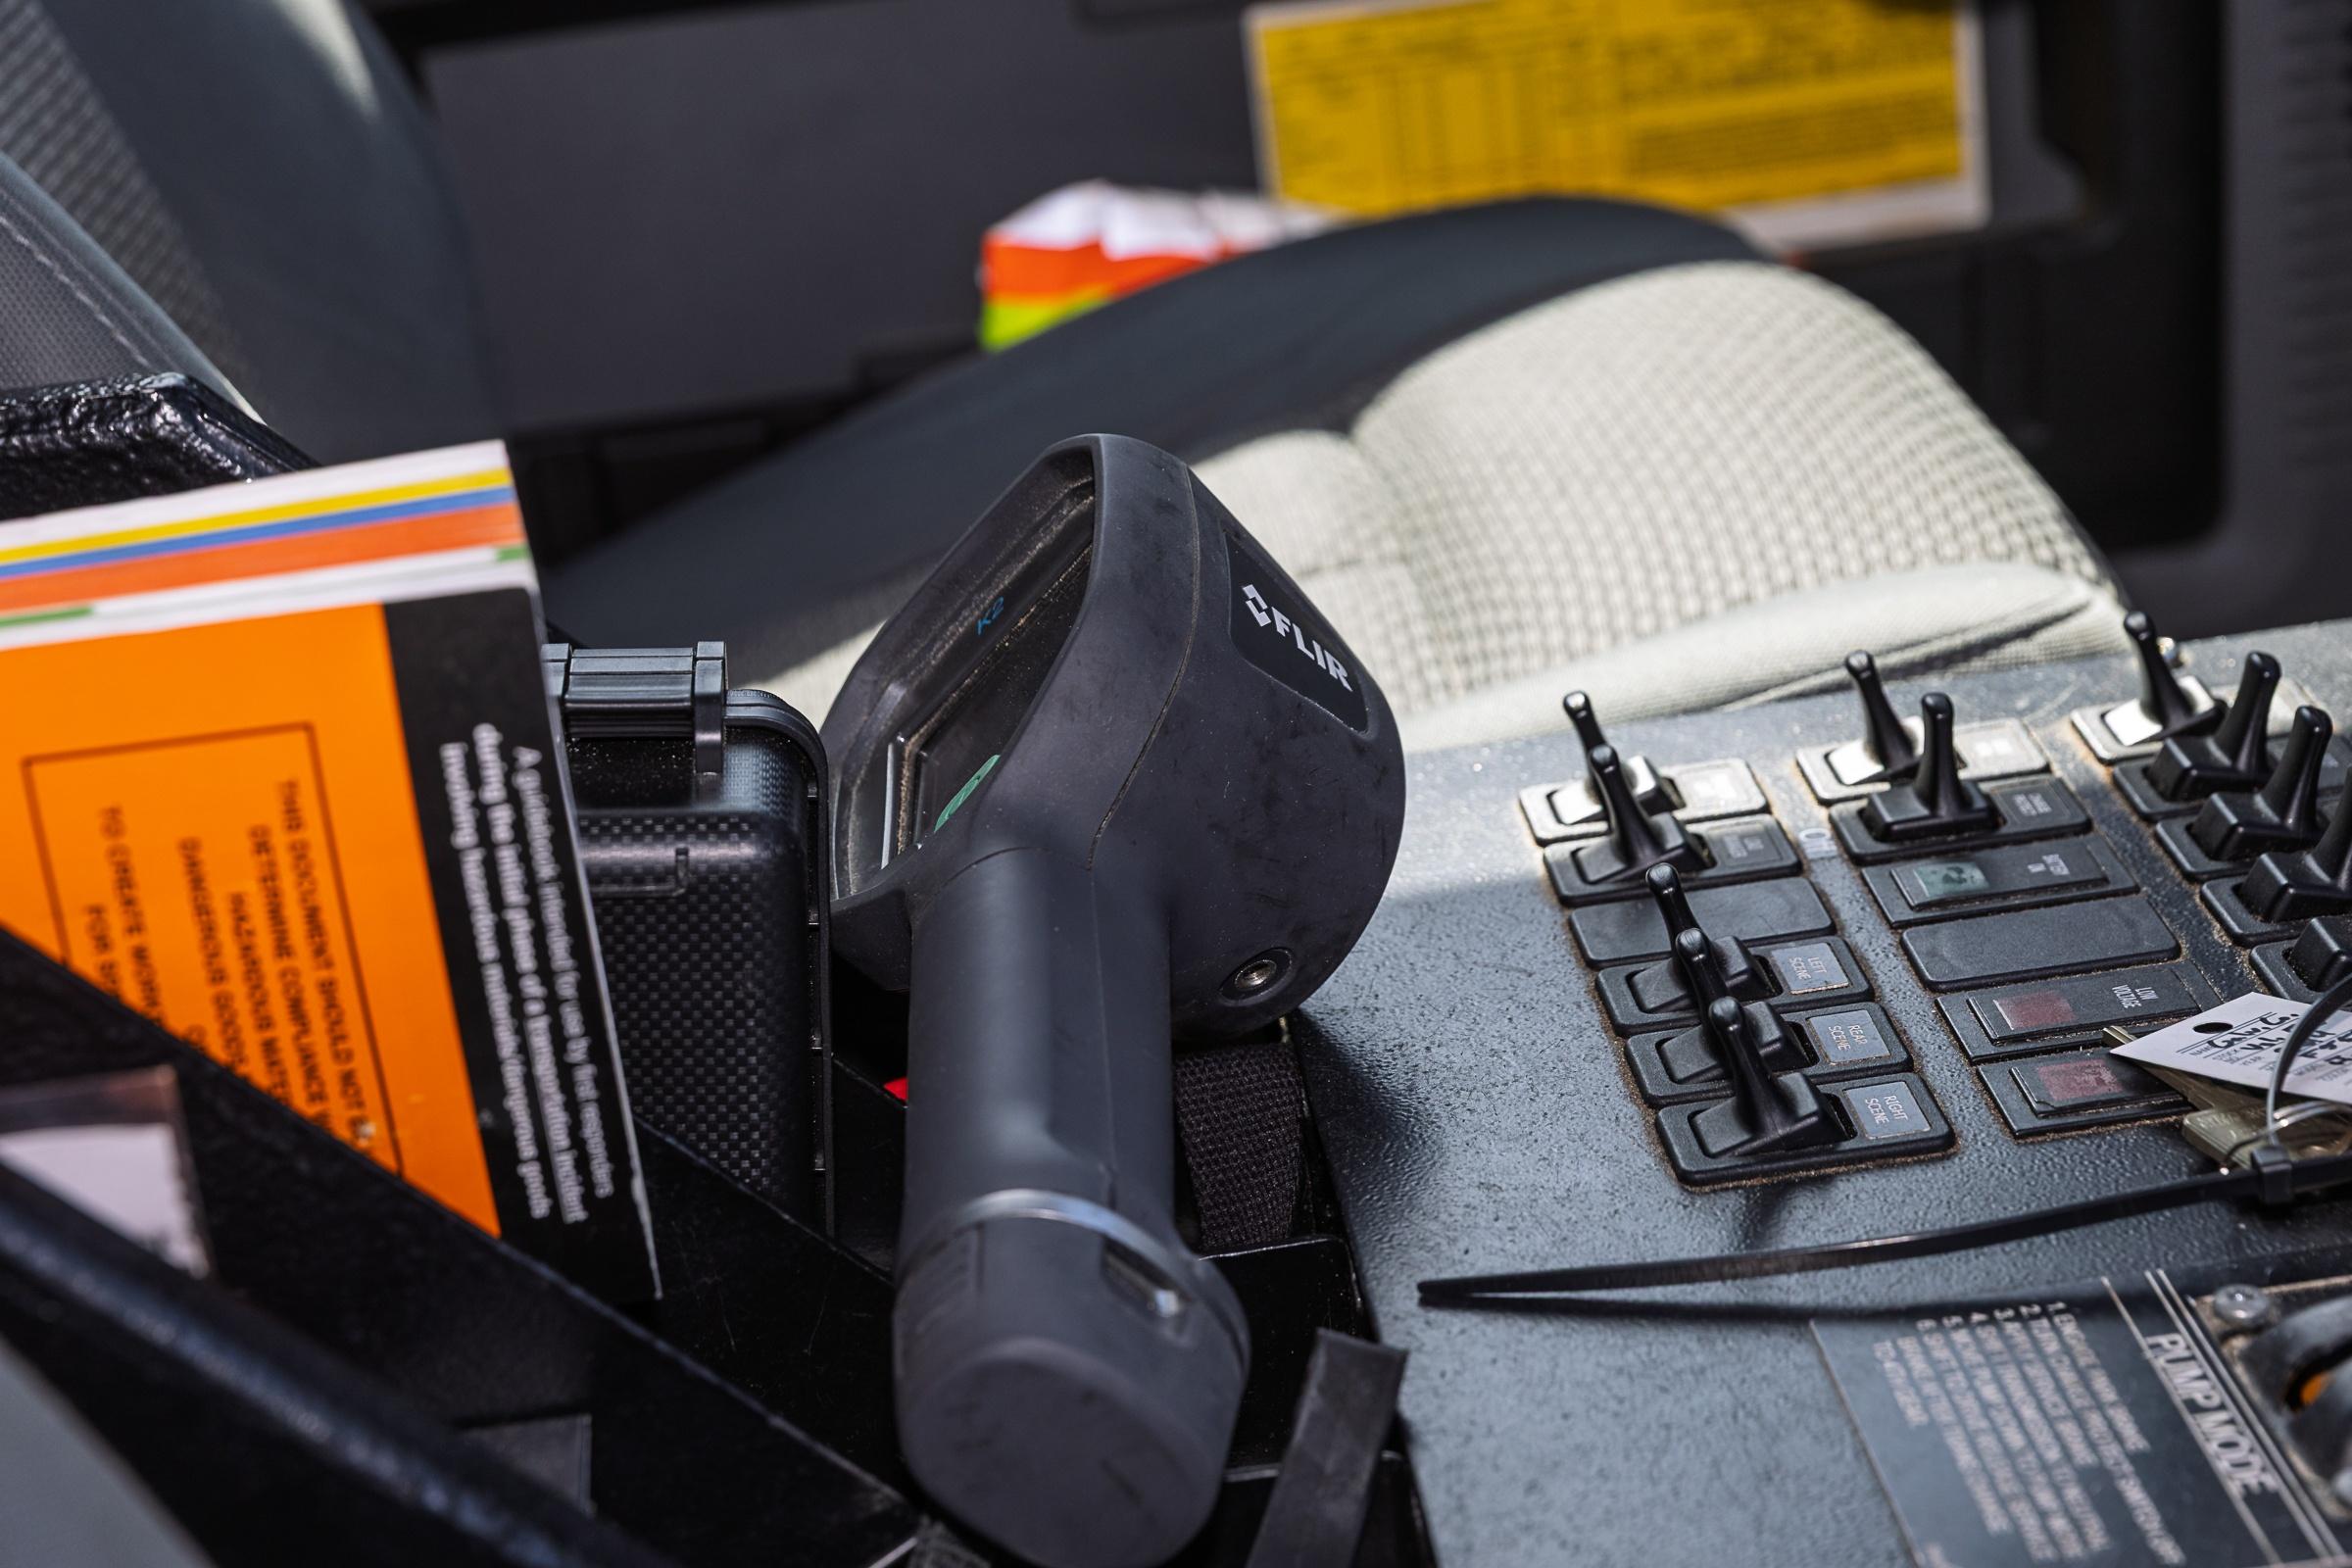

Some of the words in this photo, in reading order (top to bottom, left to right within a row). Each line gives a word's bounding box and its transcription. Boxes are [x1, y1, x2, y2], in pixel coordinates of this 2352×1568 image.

[1271, 605, 1354, 693] FLIR
[1788, 956, 1812, 982] SCENE
[1808, 956, 1836, 981] LEFT
[2112, 984, 2142, 1009] VOLTAGE
[2137, 986, 2159, 1001] LOW
[1828, 1025, 1852, 1052] SCENE
[1847, 1023, 1869, 1048] REAR
[1864, 1097, 1888, 1125] SCENE
[1884, 1094, 1908, 1124] RIGHT
[2145, 1332, 2221, 1418] PUMP
[2198, 1409, 2280, 1498] MODE
